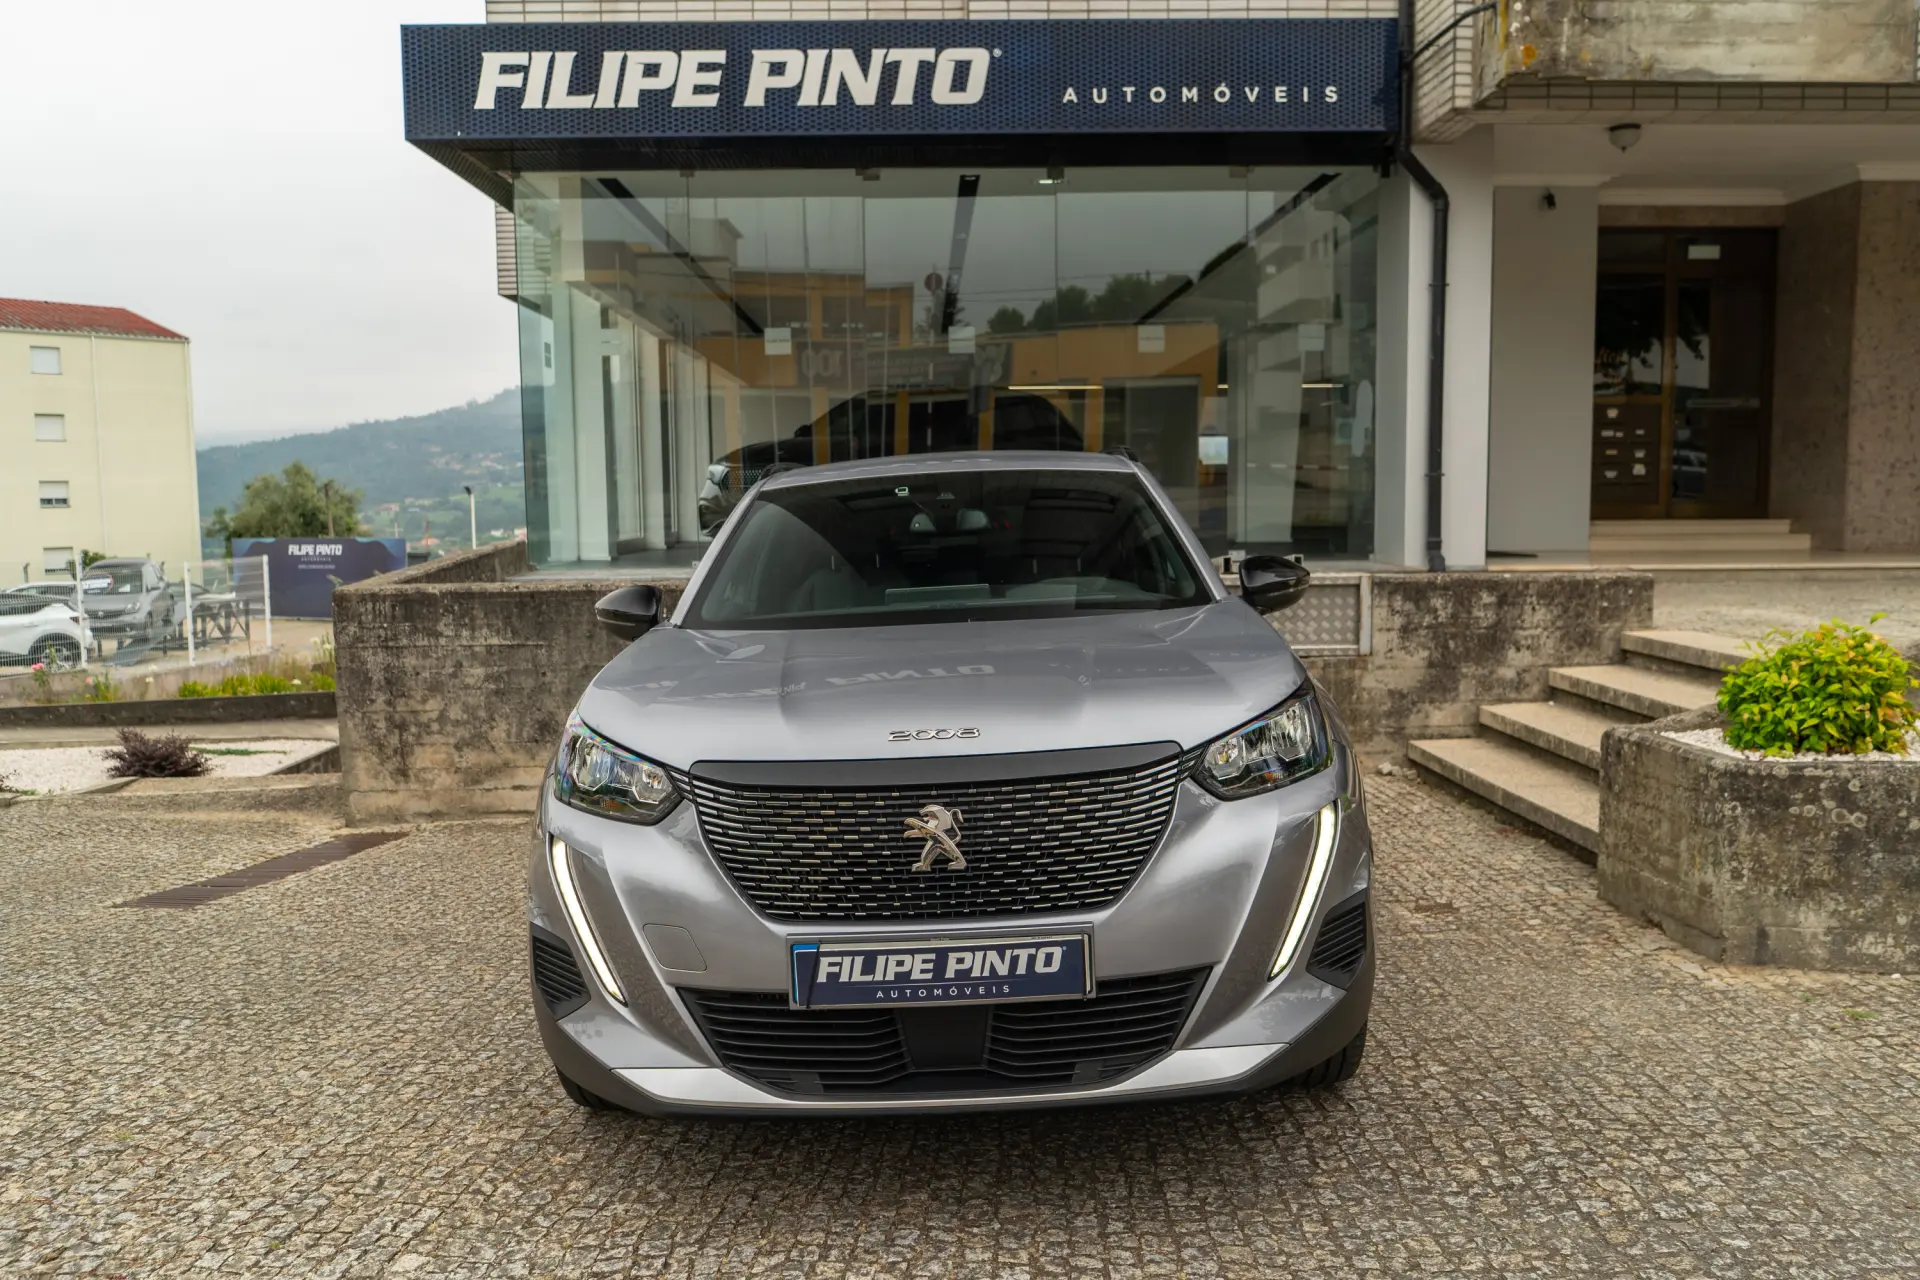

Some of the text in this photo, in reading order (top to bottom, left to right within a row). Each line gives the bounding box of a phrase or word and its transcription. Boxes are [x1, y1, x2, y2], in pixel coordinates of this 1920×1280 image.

[473, 47, 991, 110] FILIPE PINTO
[1062, 82, 1338, 104] AUTOMÓVEIS
[288, 543, 343, 556] FILIPE PINTO
[887, 727, 981, 742] 2008
[816, 945, 1063, 983] FILIPE PINTO
[876, 984, 1010, 999] AUTOMÓVEIS
